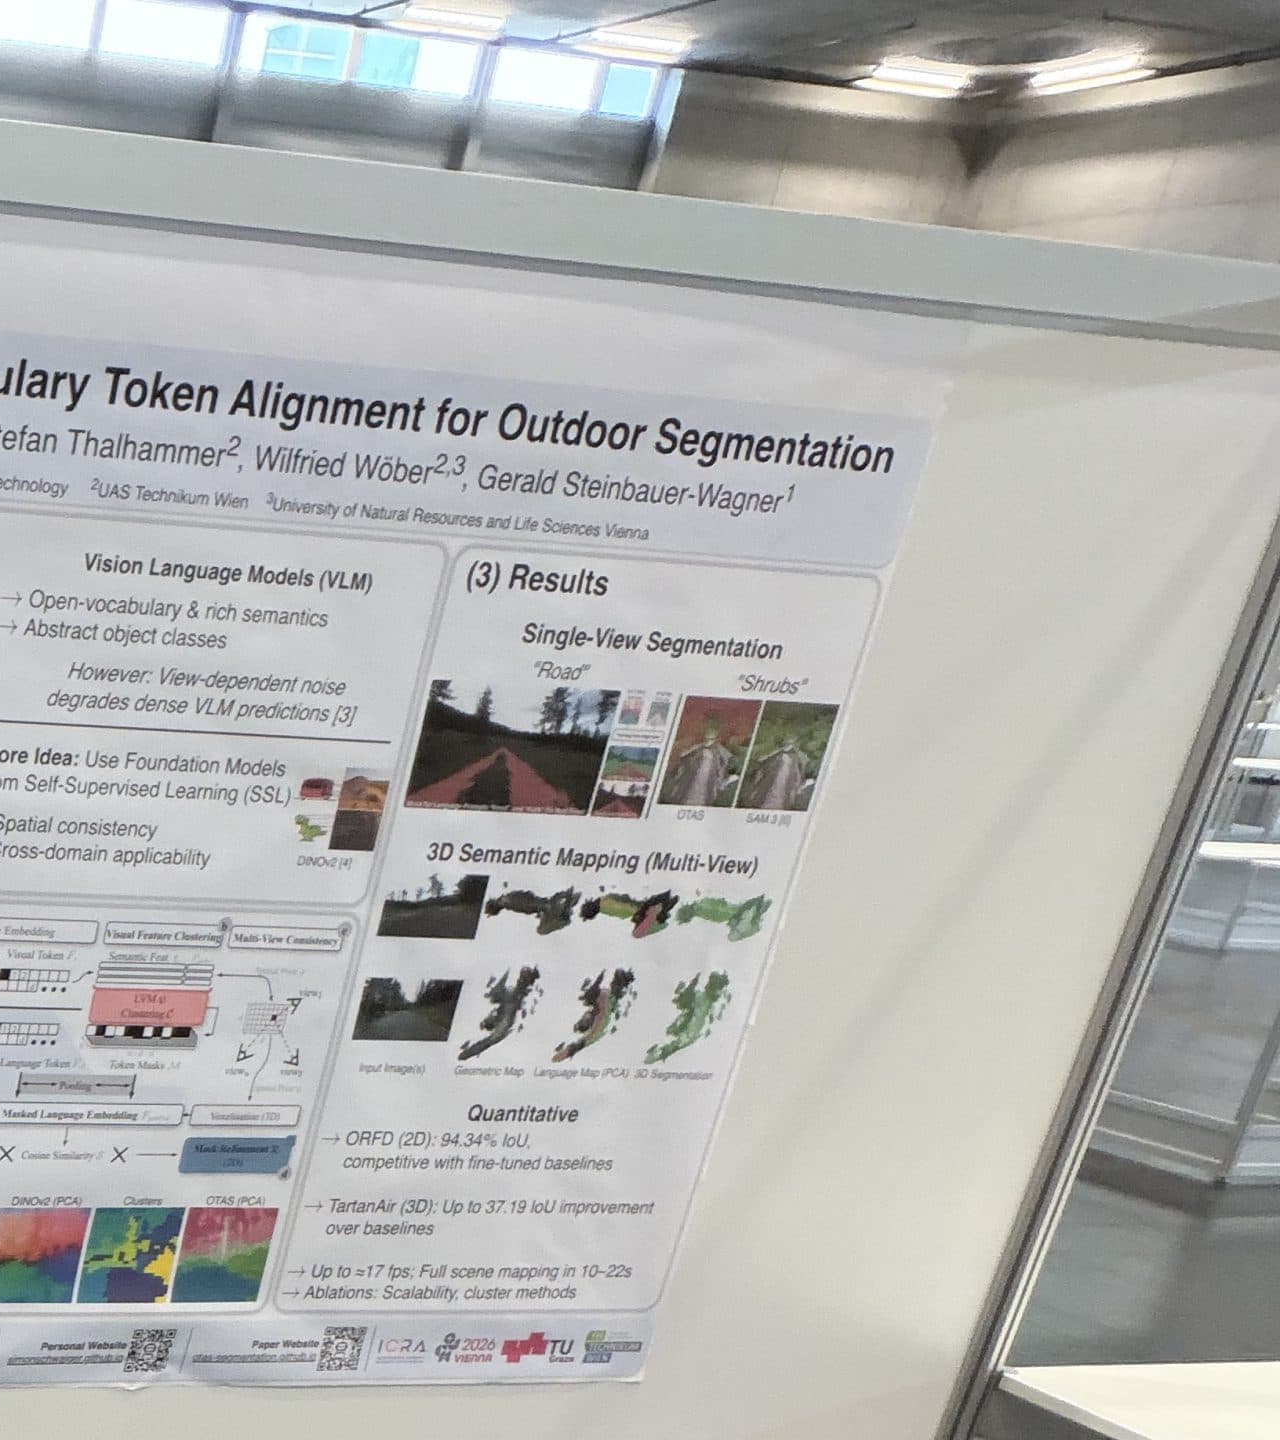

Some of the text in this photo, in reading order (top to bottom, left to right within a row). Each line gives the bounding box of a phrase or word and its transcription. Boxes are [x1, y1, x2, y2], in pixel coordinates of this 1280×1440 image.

[104, 366, 219, 414] Token
[227, 379, 426, 432] Alignment
[434, 397, 489, 437] for
[497, 402, 648, 451] Outdoor
[654, 417, 894, 473] Segmentation
[255, 444, 348, 478] Wilfried
[477, 463, 559, 495] Gerald
[135, 484, 210, 506] Technikum
[213, 491, 249, 509] Wien
[84, 552, 373, 595] Vision Language Models (VLM)
[466, 559, 609, 596] (3) Results
[28, 588, 329, 628] Open-vocabulary & rich semantics
[22, 617, 228, 649] Abstract object classes
[521, 621, 783, 660] Single-View Segmentation
[33, 746, 80, 767] Idea:
[84, 749, 120, 769] Use
[123, 751, 220, 774] Foundation
[224, 756, 286, 778] Models
[23, 773, 161, 799] Self-Supervised
[164, 780, 239, 806] Learning
[243, 784, 292, 808] (SSL)
[426, 841, 758, 879] 3D Semantic Mapping (Multi-View)
[467, 1103, 579, 1123] Quantitative
[345, 1129, 394, 1146] ORFD
[397, 1131, 437, 1150] (2D):
[439, 1131, 497, 1148] 94.34%
[342, 1153, 613, 1172] competitive with fine-tuned baselines
[310, 1263, 334, 1281] Up
[335, 1264, 352, 1279] to
[387, 1263, 415, 1282] fps;
[418, 1263, 448, 1279] Full
[449, 1266, 495, 1279] scene
[496, 1266, 560, 1282] mapping
[561, 1266, 576, 1278] in
[302, 1284, 577, 1303] Ablations: Scalability, cluster methods
